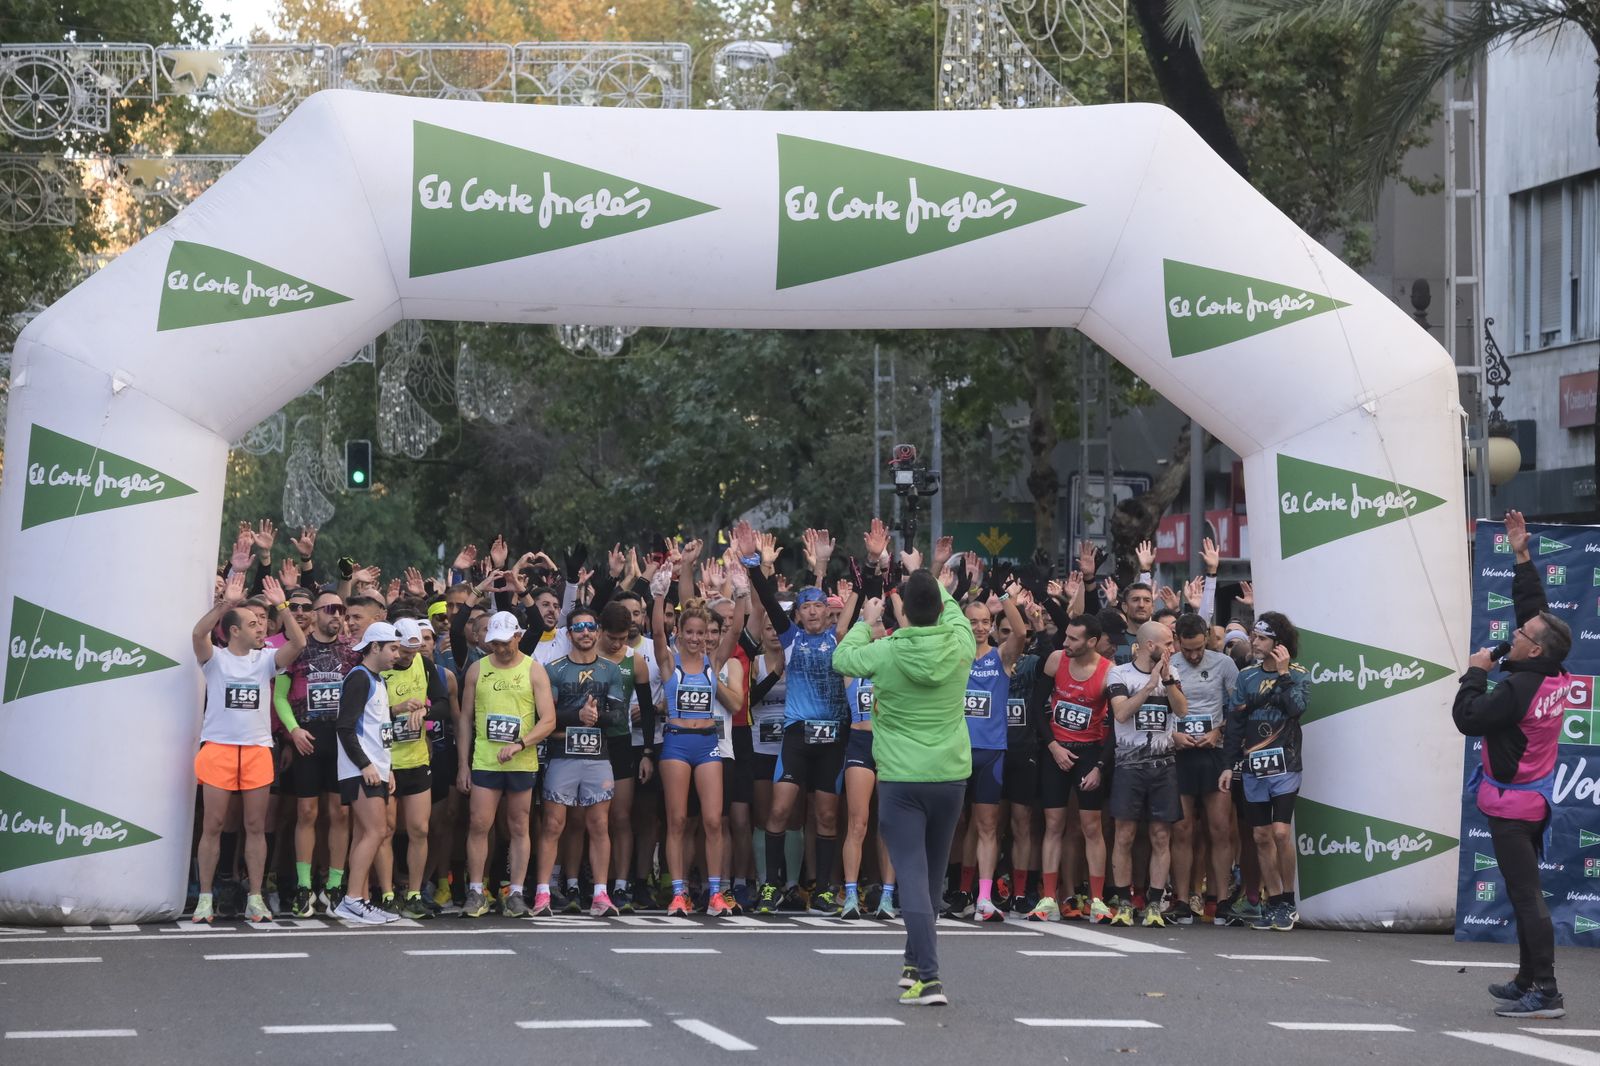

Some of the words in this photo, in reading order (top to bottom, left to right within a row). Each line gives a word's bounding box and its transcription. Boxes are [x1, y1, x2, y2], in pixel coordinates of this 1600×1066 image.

[419, 174, 452, 209] El
[461, 177, 533, 214] Corte
[539, 172, 651, 229] Inglés
[785, 186, 819, 221] El
[827, 186, 900, 221] Corte
[905, 178, 1017, 234] Inglés
[168, 270, 188, 290] El
[194, 272, 240, 295] Corte
[242, 270, 314, 307] Inglés
[1169, 296, 1191, 317] El
[1196, 296, 1243, 316] Corte
[1247, 288, 1315, 322] Inglés
[29, 463, 44, 485] El
[49, 464, 92, 487] Corte
[94, 461, 165, 498] Inglés
[1281, 492, 1299, 514] El
[1303, 491, 1347, 513] Corte
[1351, 483, 1417, 519] Inglés
[11, 636, 26, 658] El
[30, 637, 72, 661] Corte
[75, 635, 146, 672] Inglés
[1311, 662, 1354, 684] Corte
[1358, 654, 1425, 690] Inglés
[229, 689, 257, 701] 156
[312, 689, 340, 701] 345
[681, 691, 709, 703] 402
[489, 720, 517, 734] 547
[1060, 708, 1086, 724] 165
[1138, 711, 1165, 723] 519
[1185, 721, 1205, 733] 36
[571, 733, 598, 746] 105
[813, 725, 830, 737] 71
[1253, 755, 1279, 769] 571
[12, 811, 53, 835] Corte
[56, 809, 128, 846] Inglés
[1298, 833, 1315, 856] El
[1318, 833, 1361, 855] Corte
[1364, 826, 1433, 862] Inglés
